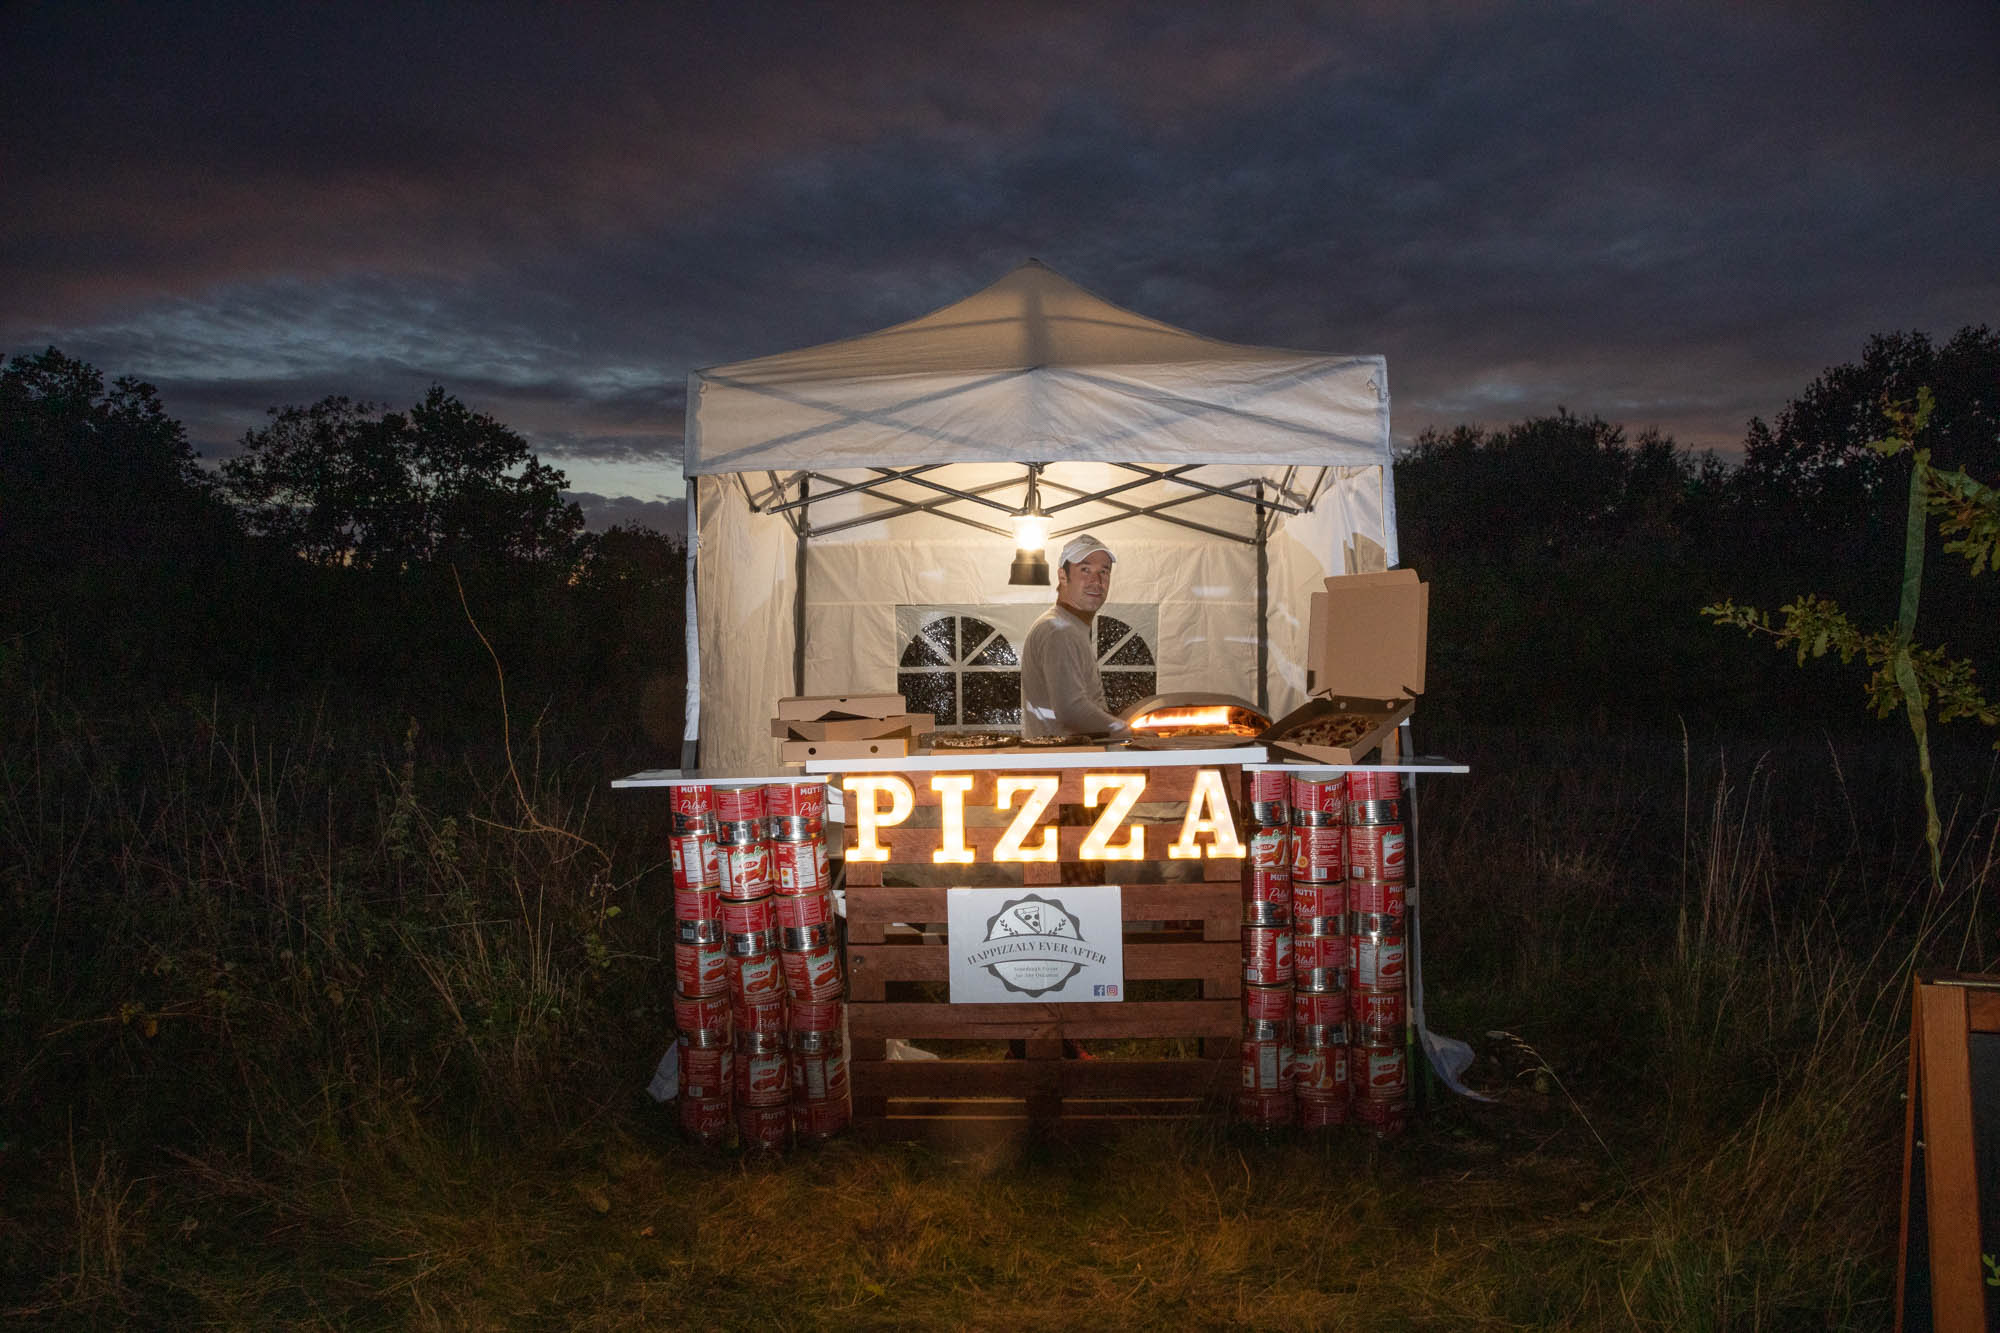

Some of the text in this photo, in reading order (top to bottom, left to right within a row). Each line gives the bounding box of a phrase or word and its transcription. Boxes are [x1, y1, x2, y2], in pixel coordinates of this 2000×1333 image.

[842, 769, 1247, 864] PIZZA
[968, 942, 1106, 965] HAPPIZZALY EVER AFTER
